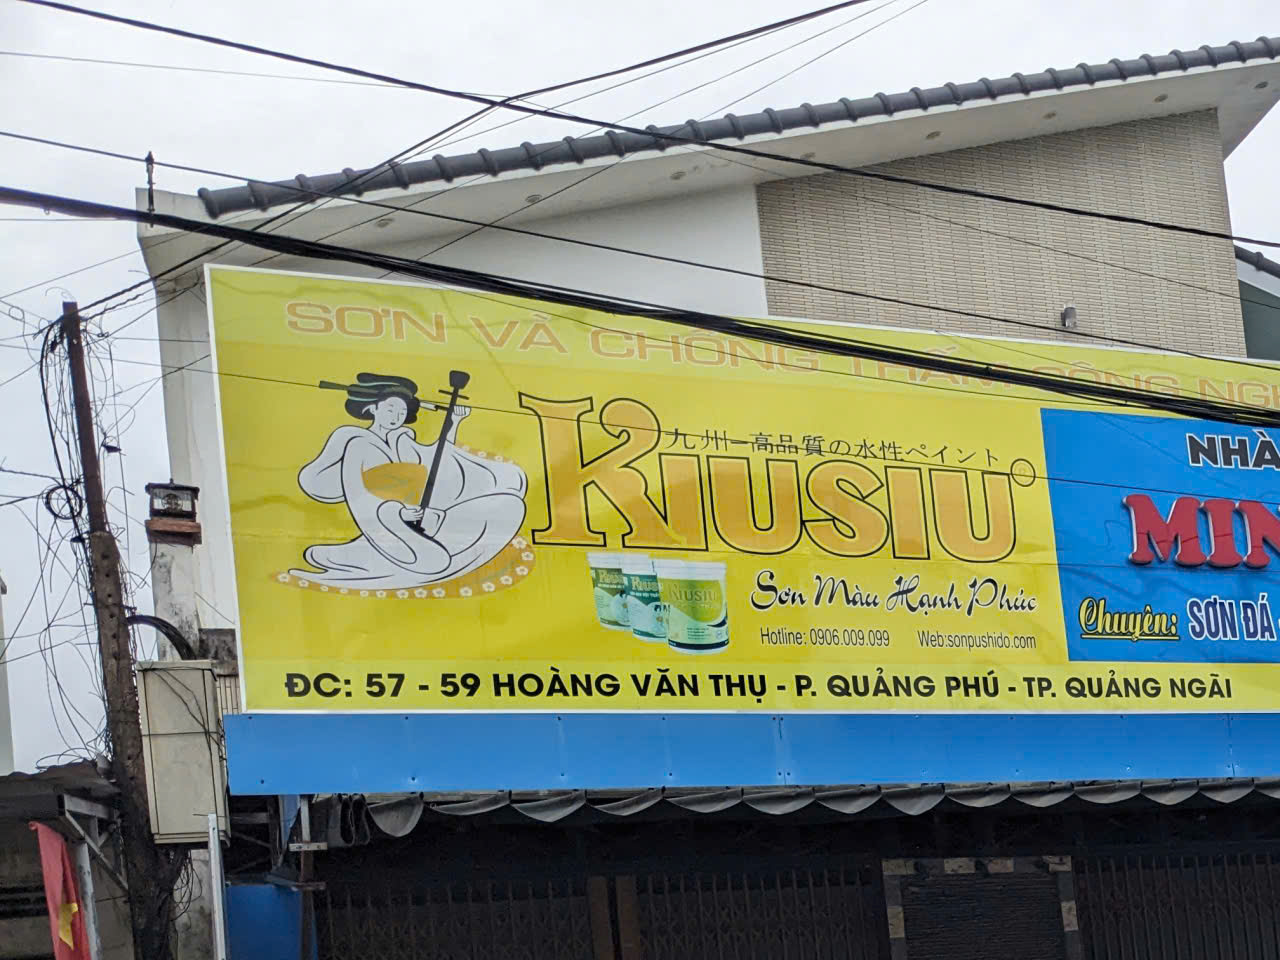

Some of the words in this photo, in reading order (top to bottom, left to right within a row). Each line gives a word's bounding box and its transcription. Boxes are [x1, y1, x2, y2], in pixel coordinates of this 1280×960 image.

[286, 301, 448, 345] SƠN
[470, 313, 569, 354] VÀ
[518, 392, 1017, 563] KIUSIU
[751, 570, 808, 611] Sơn
[814, 575, 880, 608] Màu
[886, 574, 963, 616] Hạnh
[966, 577, 1038, 617] Phúc
[760, 627, 808, 647] Hotline:
[809, 629, 890, 647] 0906.009.099
[917, 630, 1037, 651] Web:sonpushido.com
[1078, 598, 1180, 642] Chuyên:
[1187, 597, 1237, 641] SƠN
[1242, 595, 1276, 642] ĐÁ
[285, 673, 352, 698] ĐC:
[365, 673, 405, 698] 57
[440, 673, 481, 698] 59
[492, 666, 621, 698] HOÀNG
[630, 668, 699, 698] VĂN
[708, 673, 767, 704] THỤ
[795, 675, 818, 698] P.
[827, 667, 937, 698] QUẢNG
[944, 670, 1000, 698] PHÚ
[1023, 676, 1057, 698] TP.
[1065, 669, 1162, 700] QUẢNG
[1170, 670, 1232, 699] NGÃI
